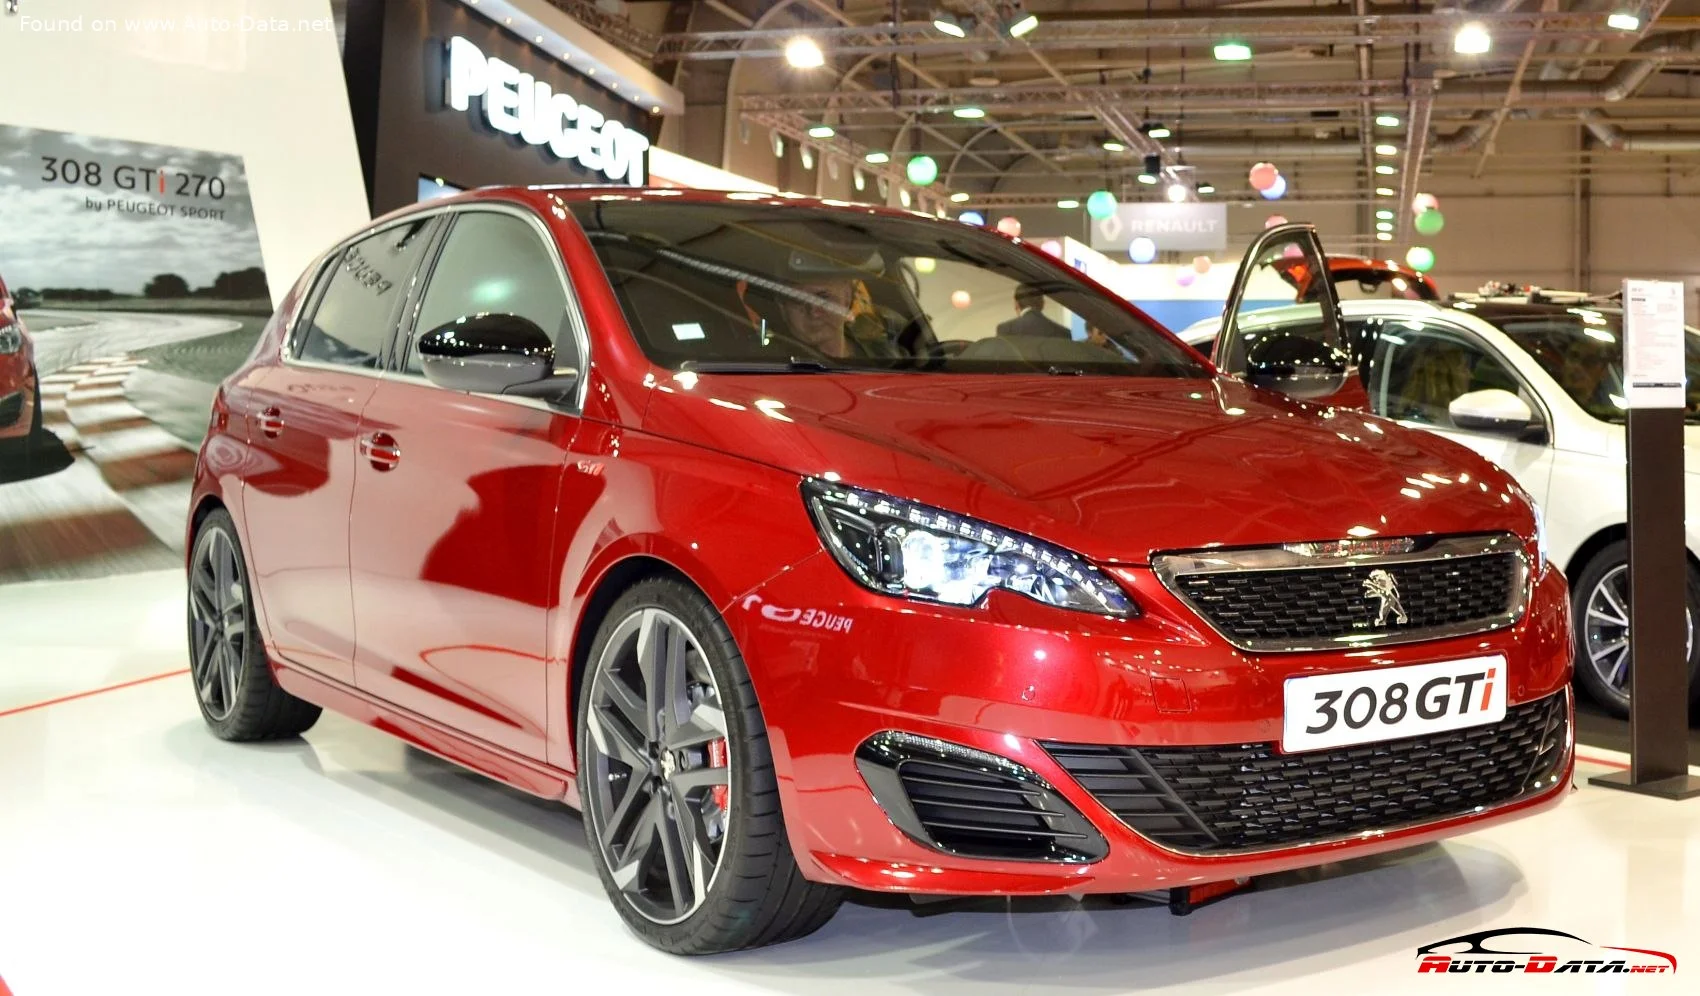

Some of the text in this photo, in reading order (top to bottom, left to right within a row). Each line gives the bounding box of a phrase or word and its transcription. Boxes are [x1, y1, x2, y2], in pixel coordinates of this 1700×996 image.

[451, 36, 649, 187] PEUGEOT
[41, 156, 225, 200] 308 GTi 270
[85, 196, 226, 221] by PEUGEOT SPORT
[1131, 219, 1217, 233] RENAULT
